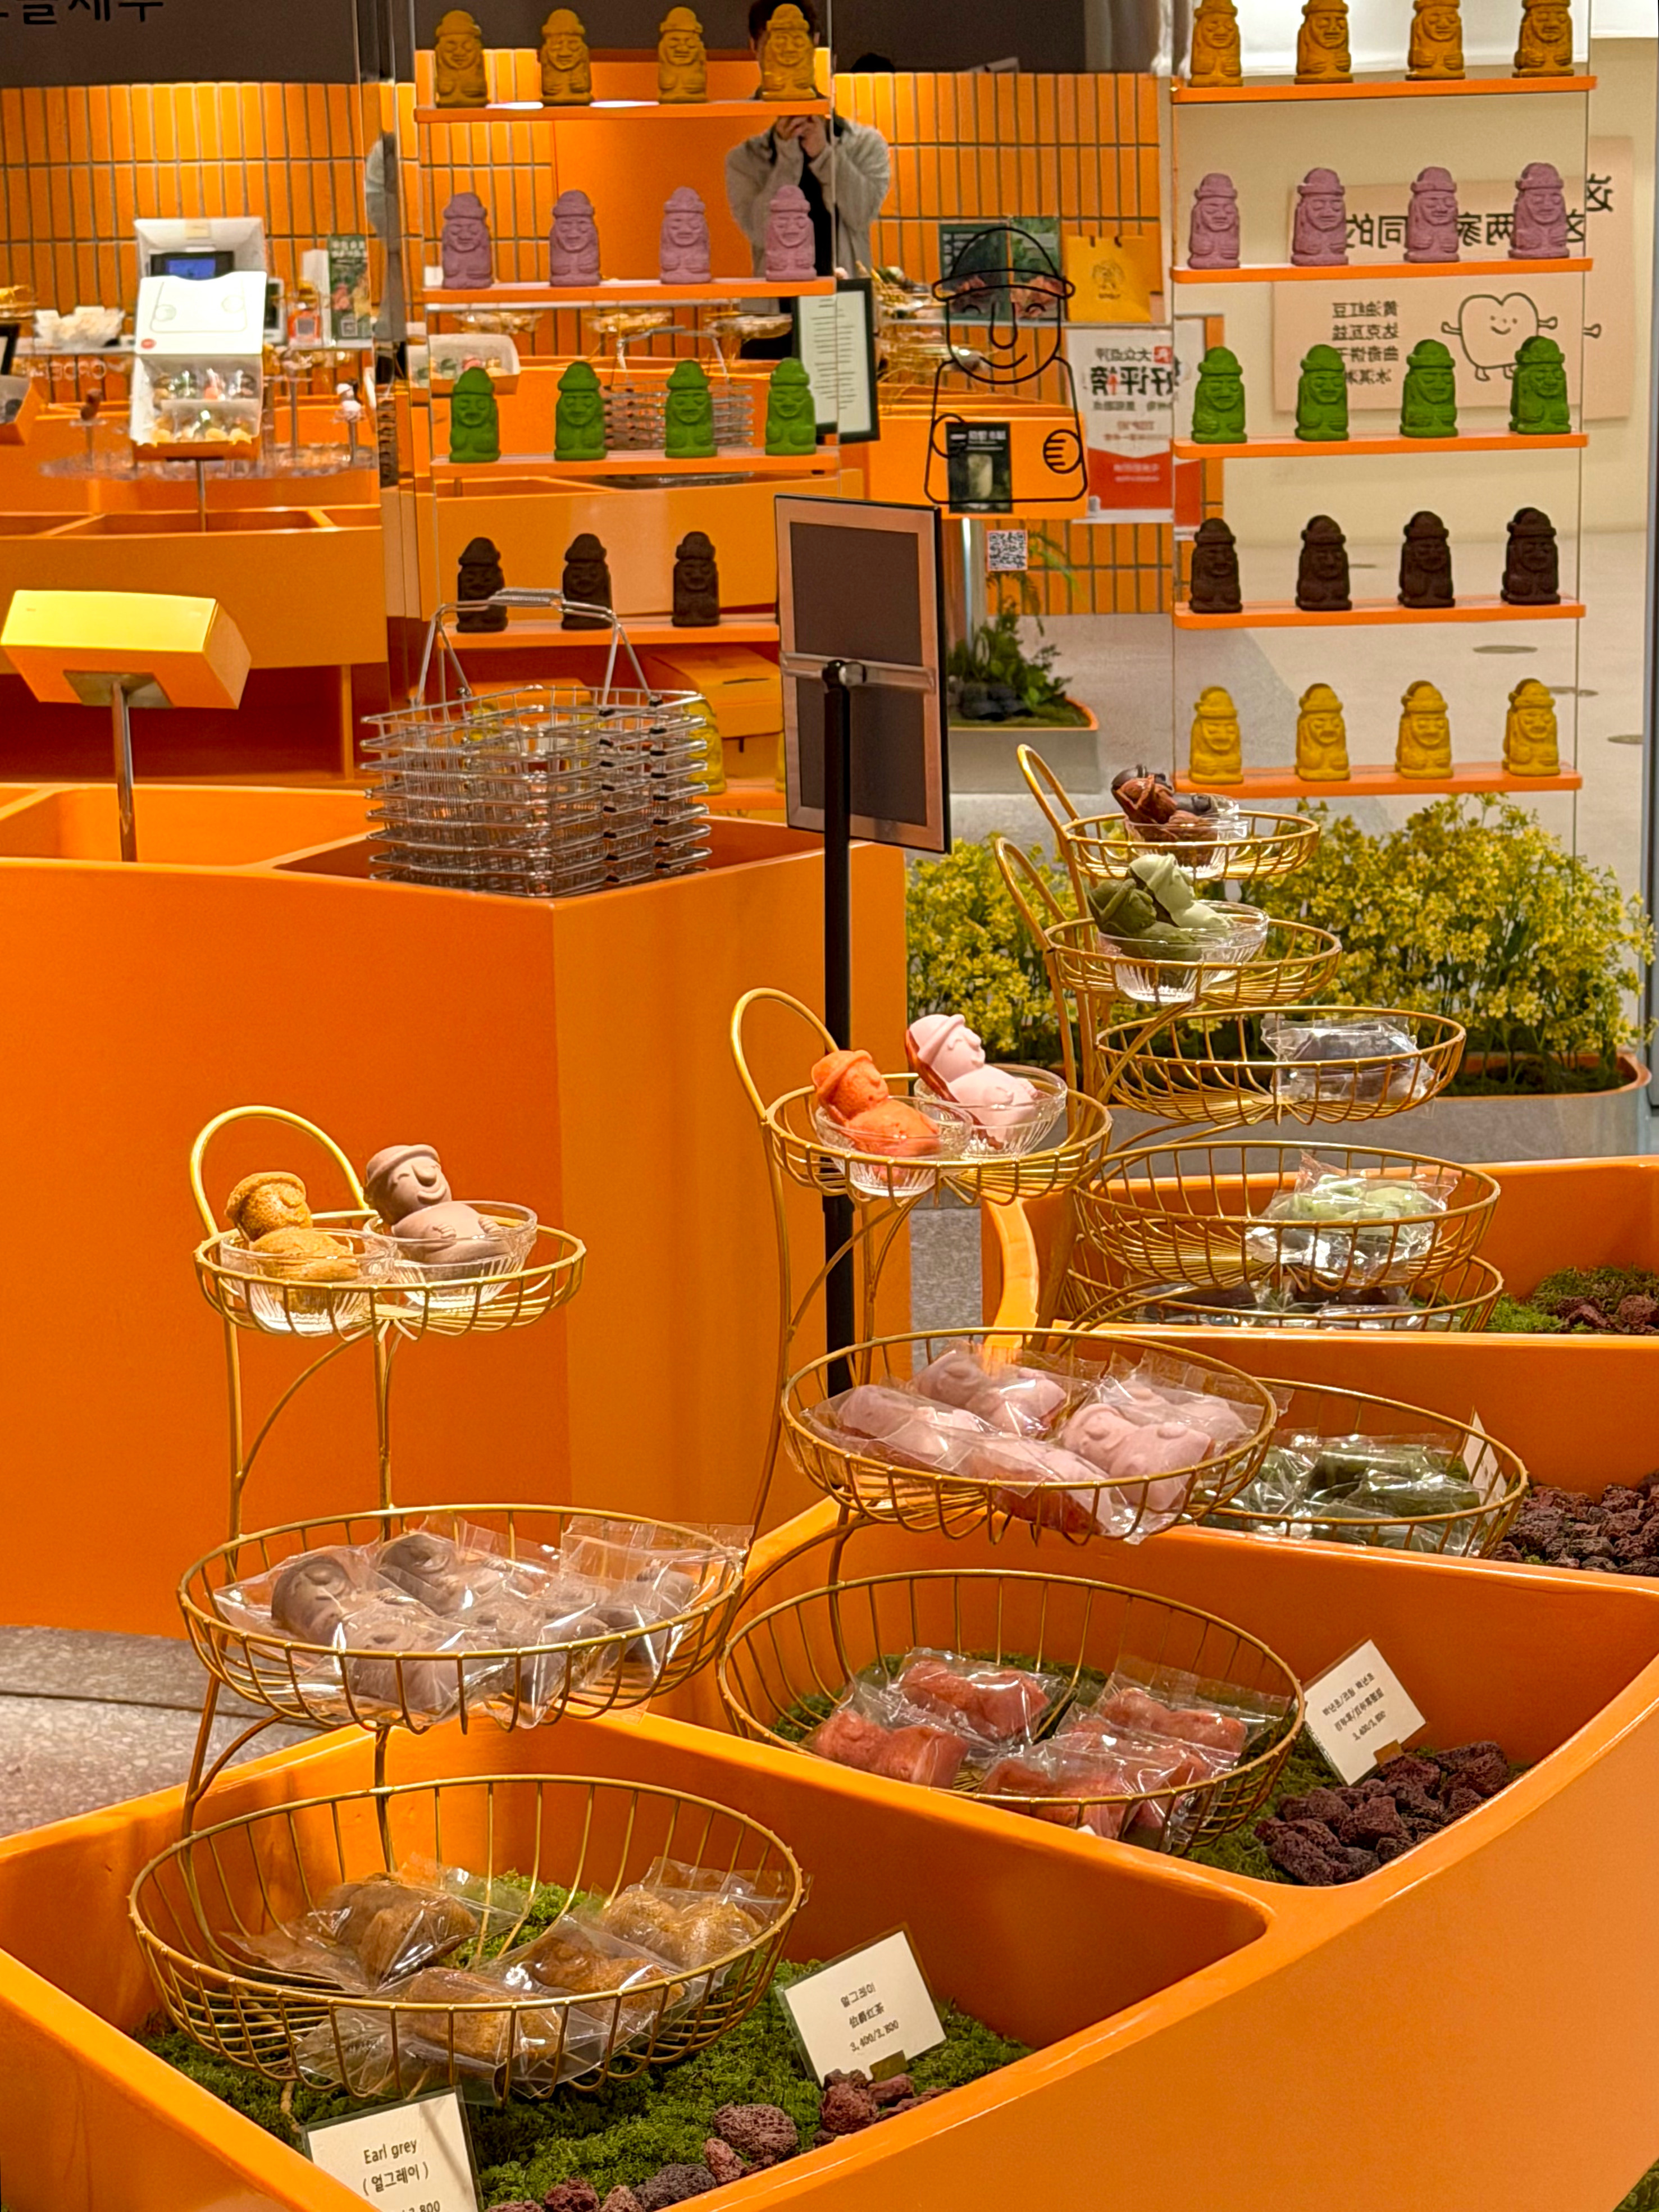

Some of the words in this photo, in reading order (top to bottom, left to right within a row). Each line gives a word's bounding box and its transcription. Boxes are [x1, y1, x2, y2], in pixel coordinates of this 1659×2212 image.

[841, 1983, 876, 2007] 얼그레이
[363, 2143, 388, 2164] Earl
[391, 2139, 417, 2159] grey
